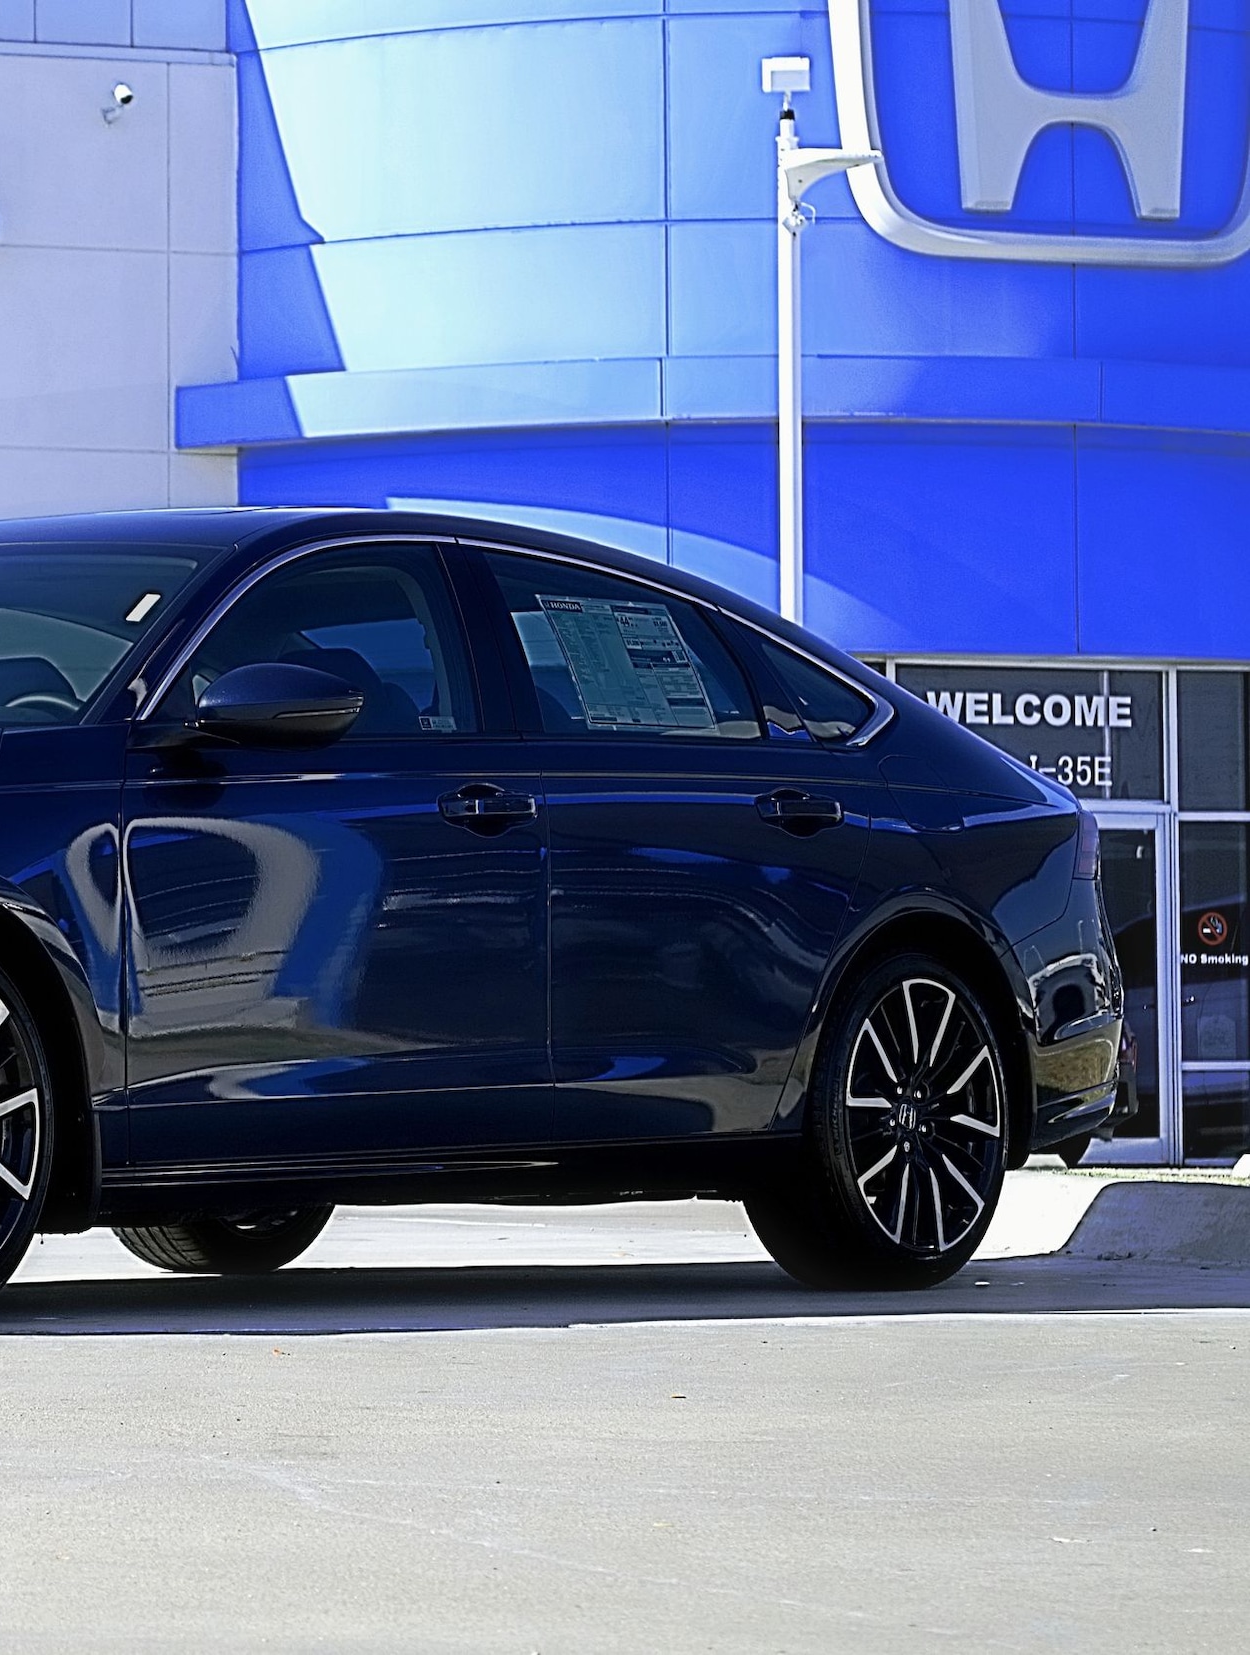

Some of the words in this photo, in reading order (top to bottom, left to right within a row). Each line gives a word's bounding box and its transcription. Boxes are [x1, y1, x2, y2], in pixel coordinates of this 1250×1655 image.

[550, 601, 581, 610] HONDA
[926, 691, 1132, 728] WELCOME
[1180, 953, 1197, 964] NO
[1200, 953, 1249, 966] Smoking
